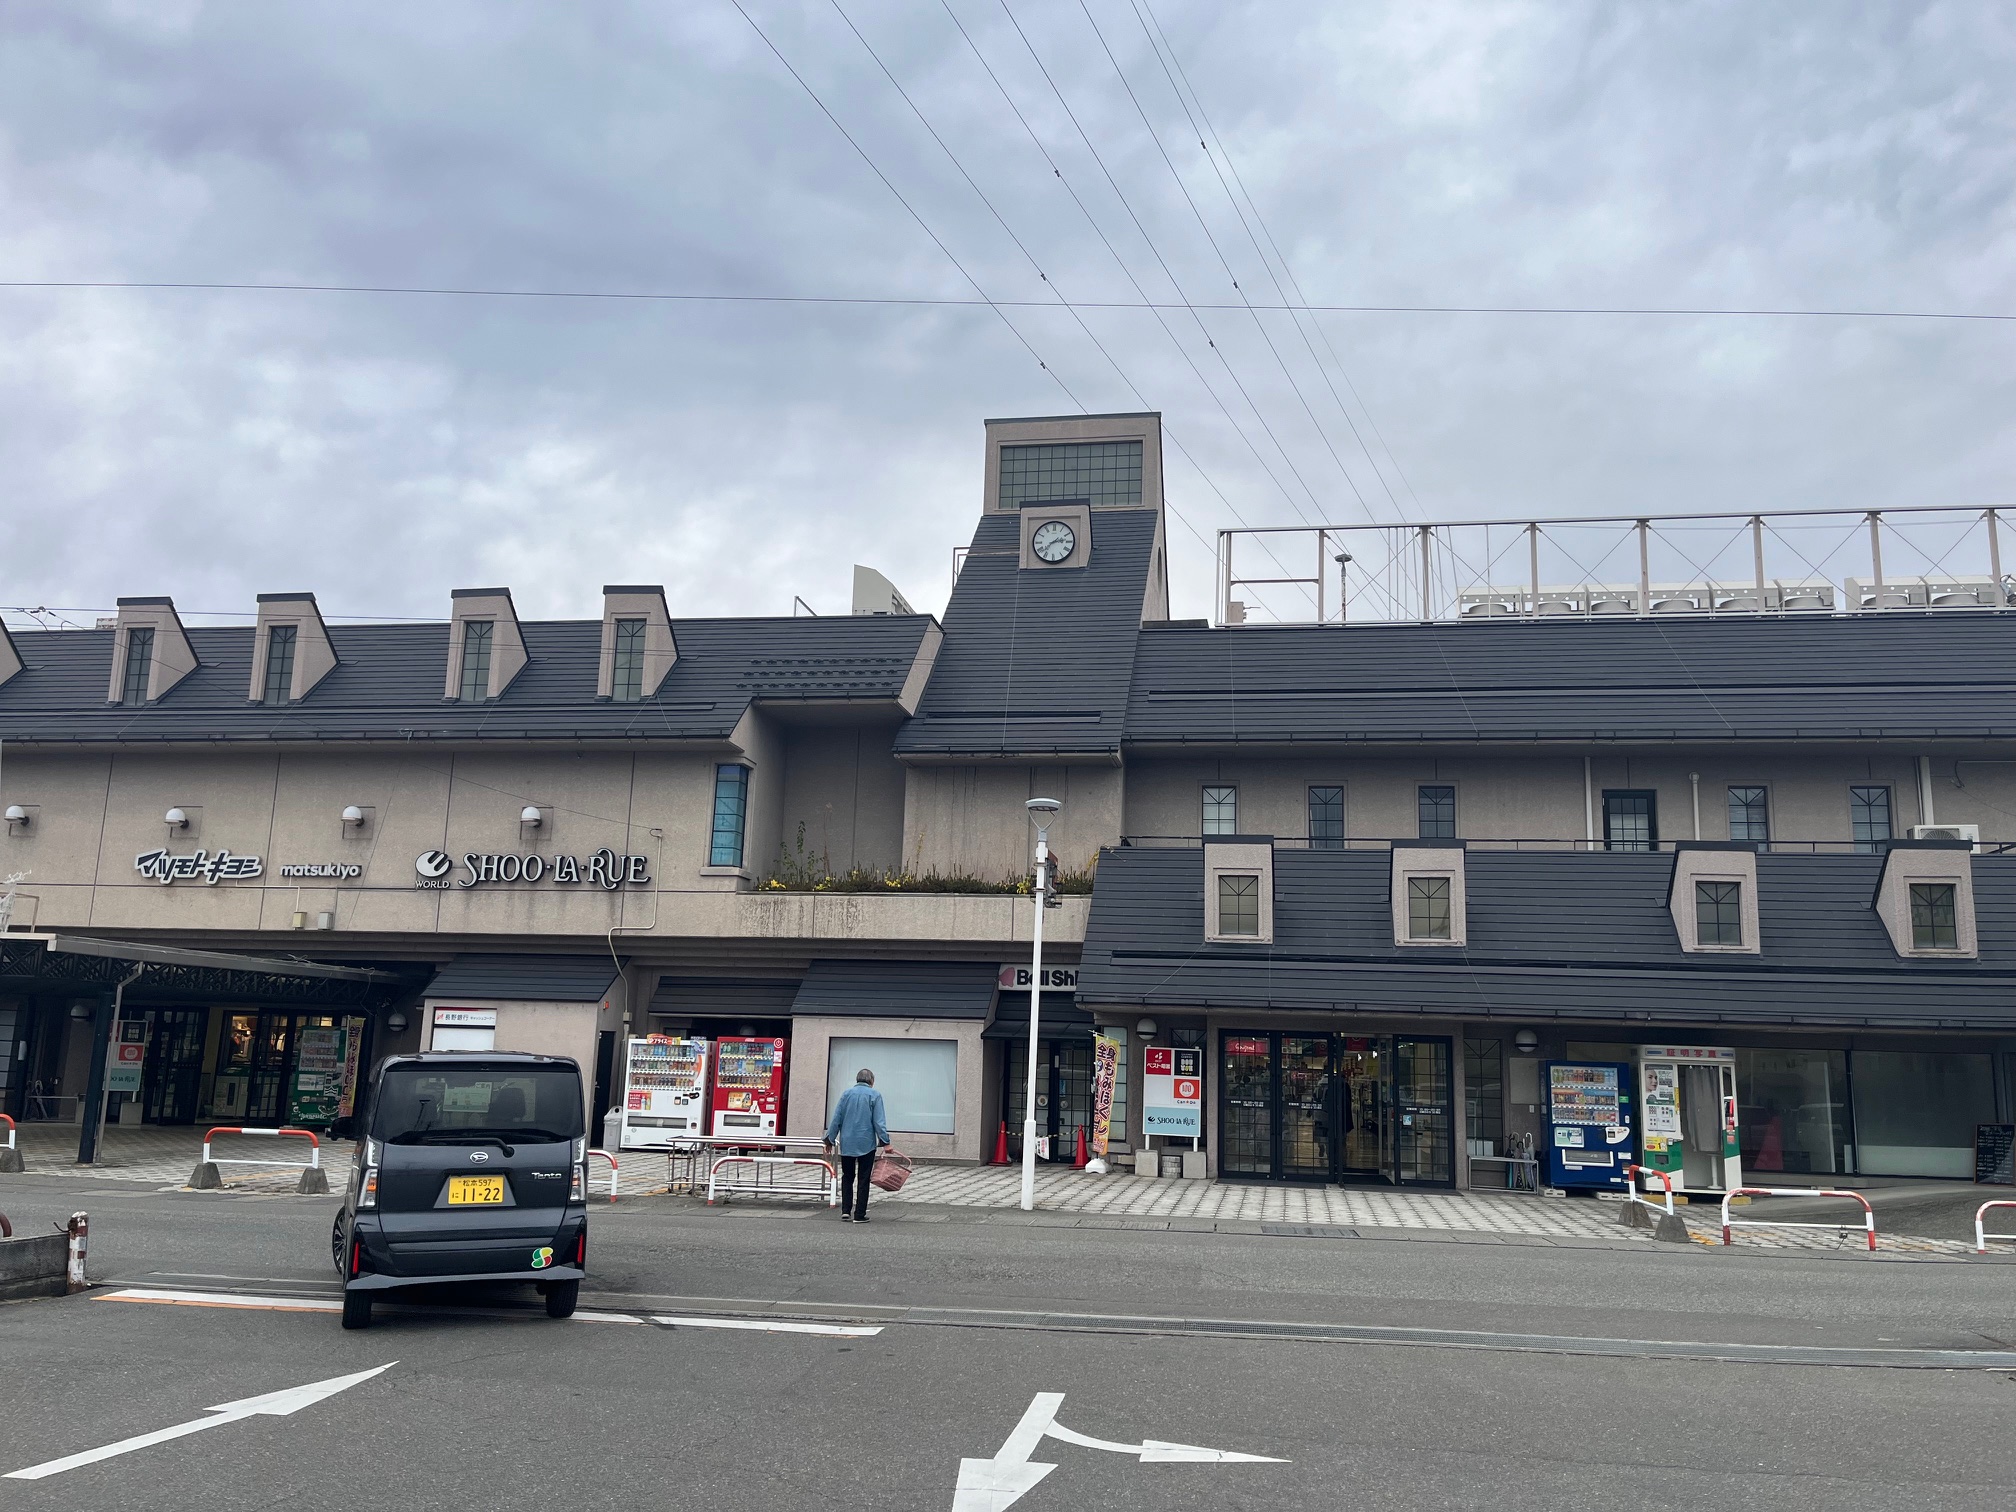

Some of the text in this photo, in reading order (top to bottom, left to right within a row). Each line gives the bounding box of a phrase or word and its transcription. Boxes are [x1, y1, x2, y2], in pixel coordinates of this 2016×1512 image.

[136, 848, 263, 884] マツモトキヨシ
[280, 862, 360, 879] matsukiyo
[415, 880, 450, 889] WORLD
[445, 1013, 469, 1022] 長野銀行
[1666, 1048, 1717, 1058] 証明写真
[531, 1172, 562, 1180] Tanto
[463, 1187, 500, 1202] 11-22
